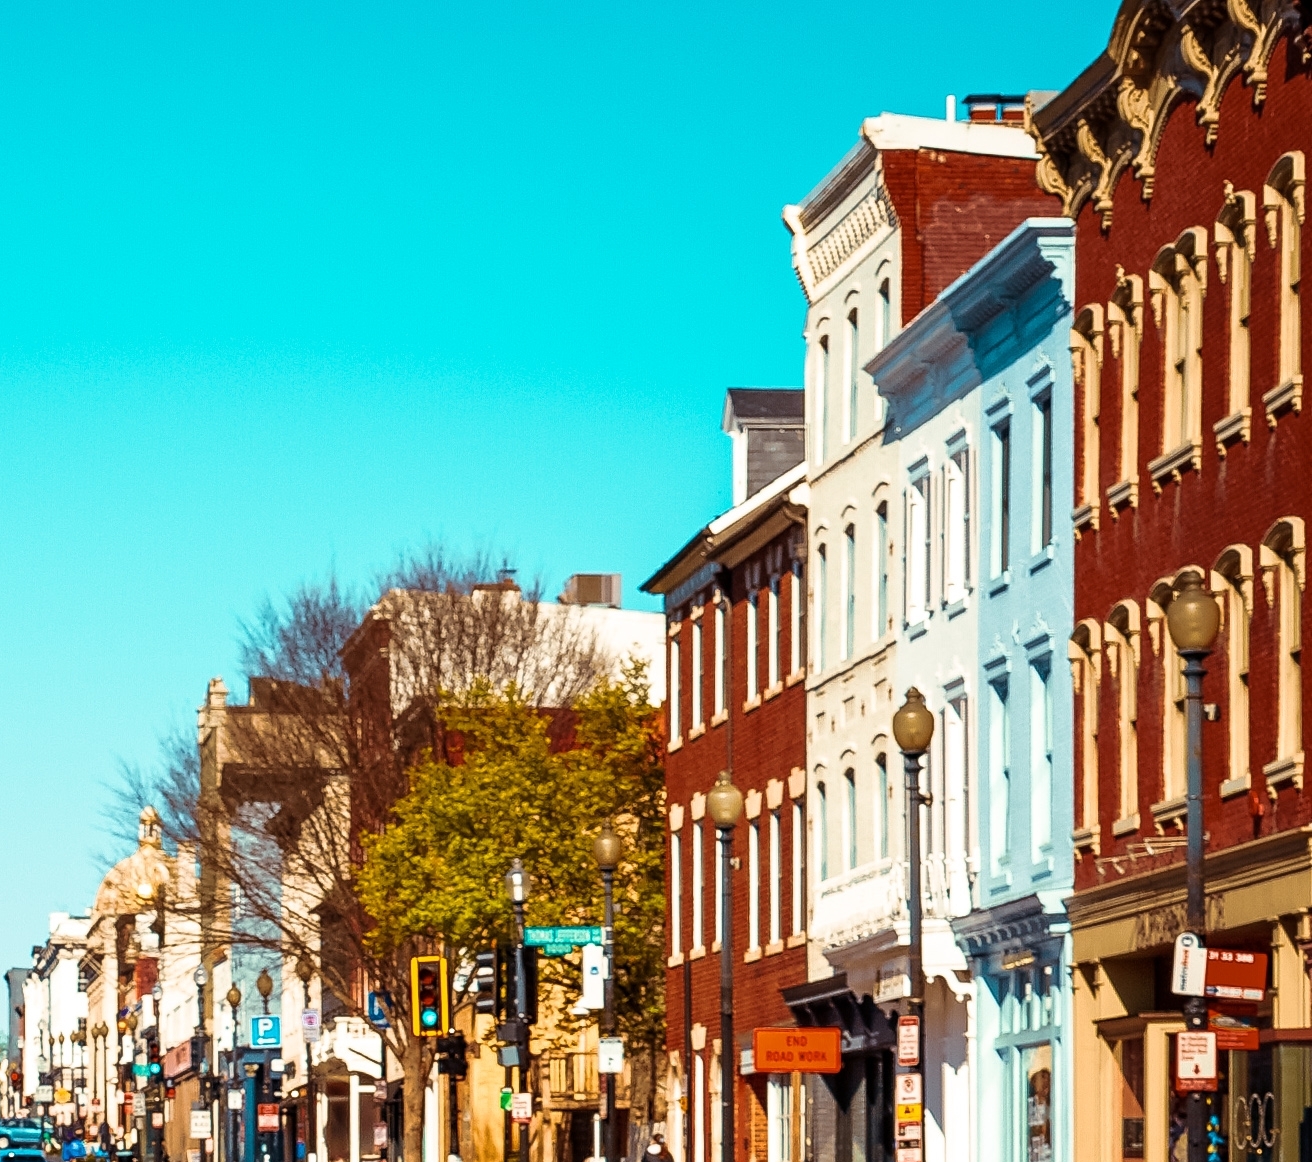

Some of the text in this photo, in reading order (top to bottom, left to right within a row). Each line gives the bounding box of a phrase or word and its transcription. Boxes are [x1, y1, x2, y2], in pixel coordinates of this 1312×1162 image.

[257, 1018, 274, 1036] P
[786, 1035, 807, 1047] END
[766, 1050, 827, 1063] ROAD WORK
